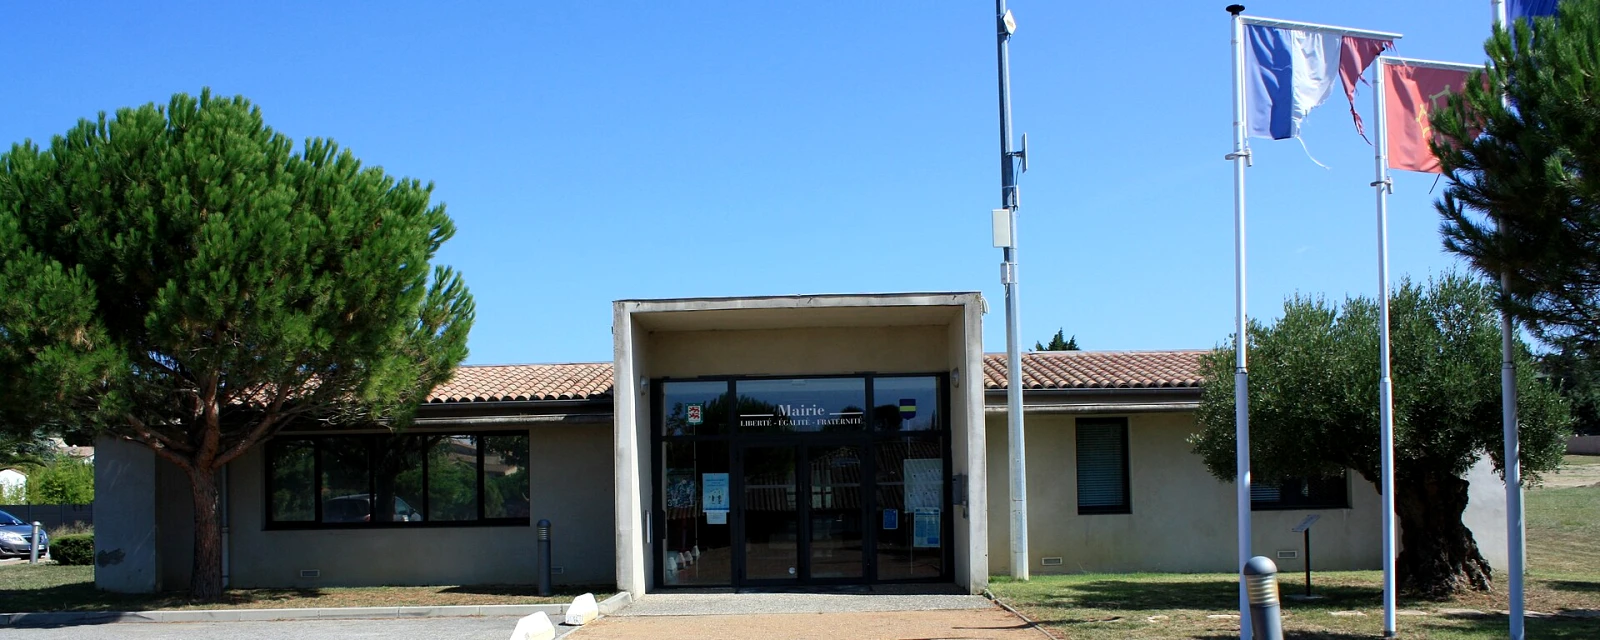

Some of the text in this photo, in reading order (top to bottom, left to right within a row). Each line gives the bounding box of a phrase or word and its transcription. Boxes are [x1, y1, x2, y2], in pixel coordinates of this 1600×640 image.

[778, 404, 825, 417] Mairie
[740, 418, 772, 427] LIBERTÉ
[778, 417, 810, 427] ÉGALITÉ
[817, 416, 863, 426] FRATERNITÉ
